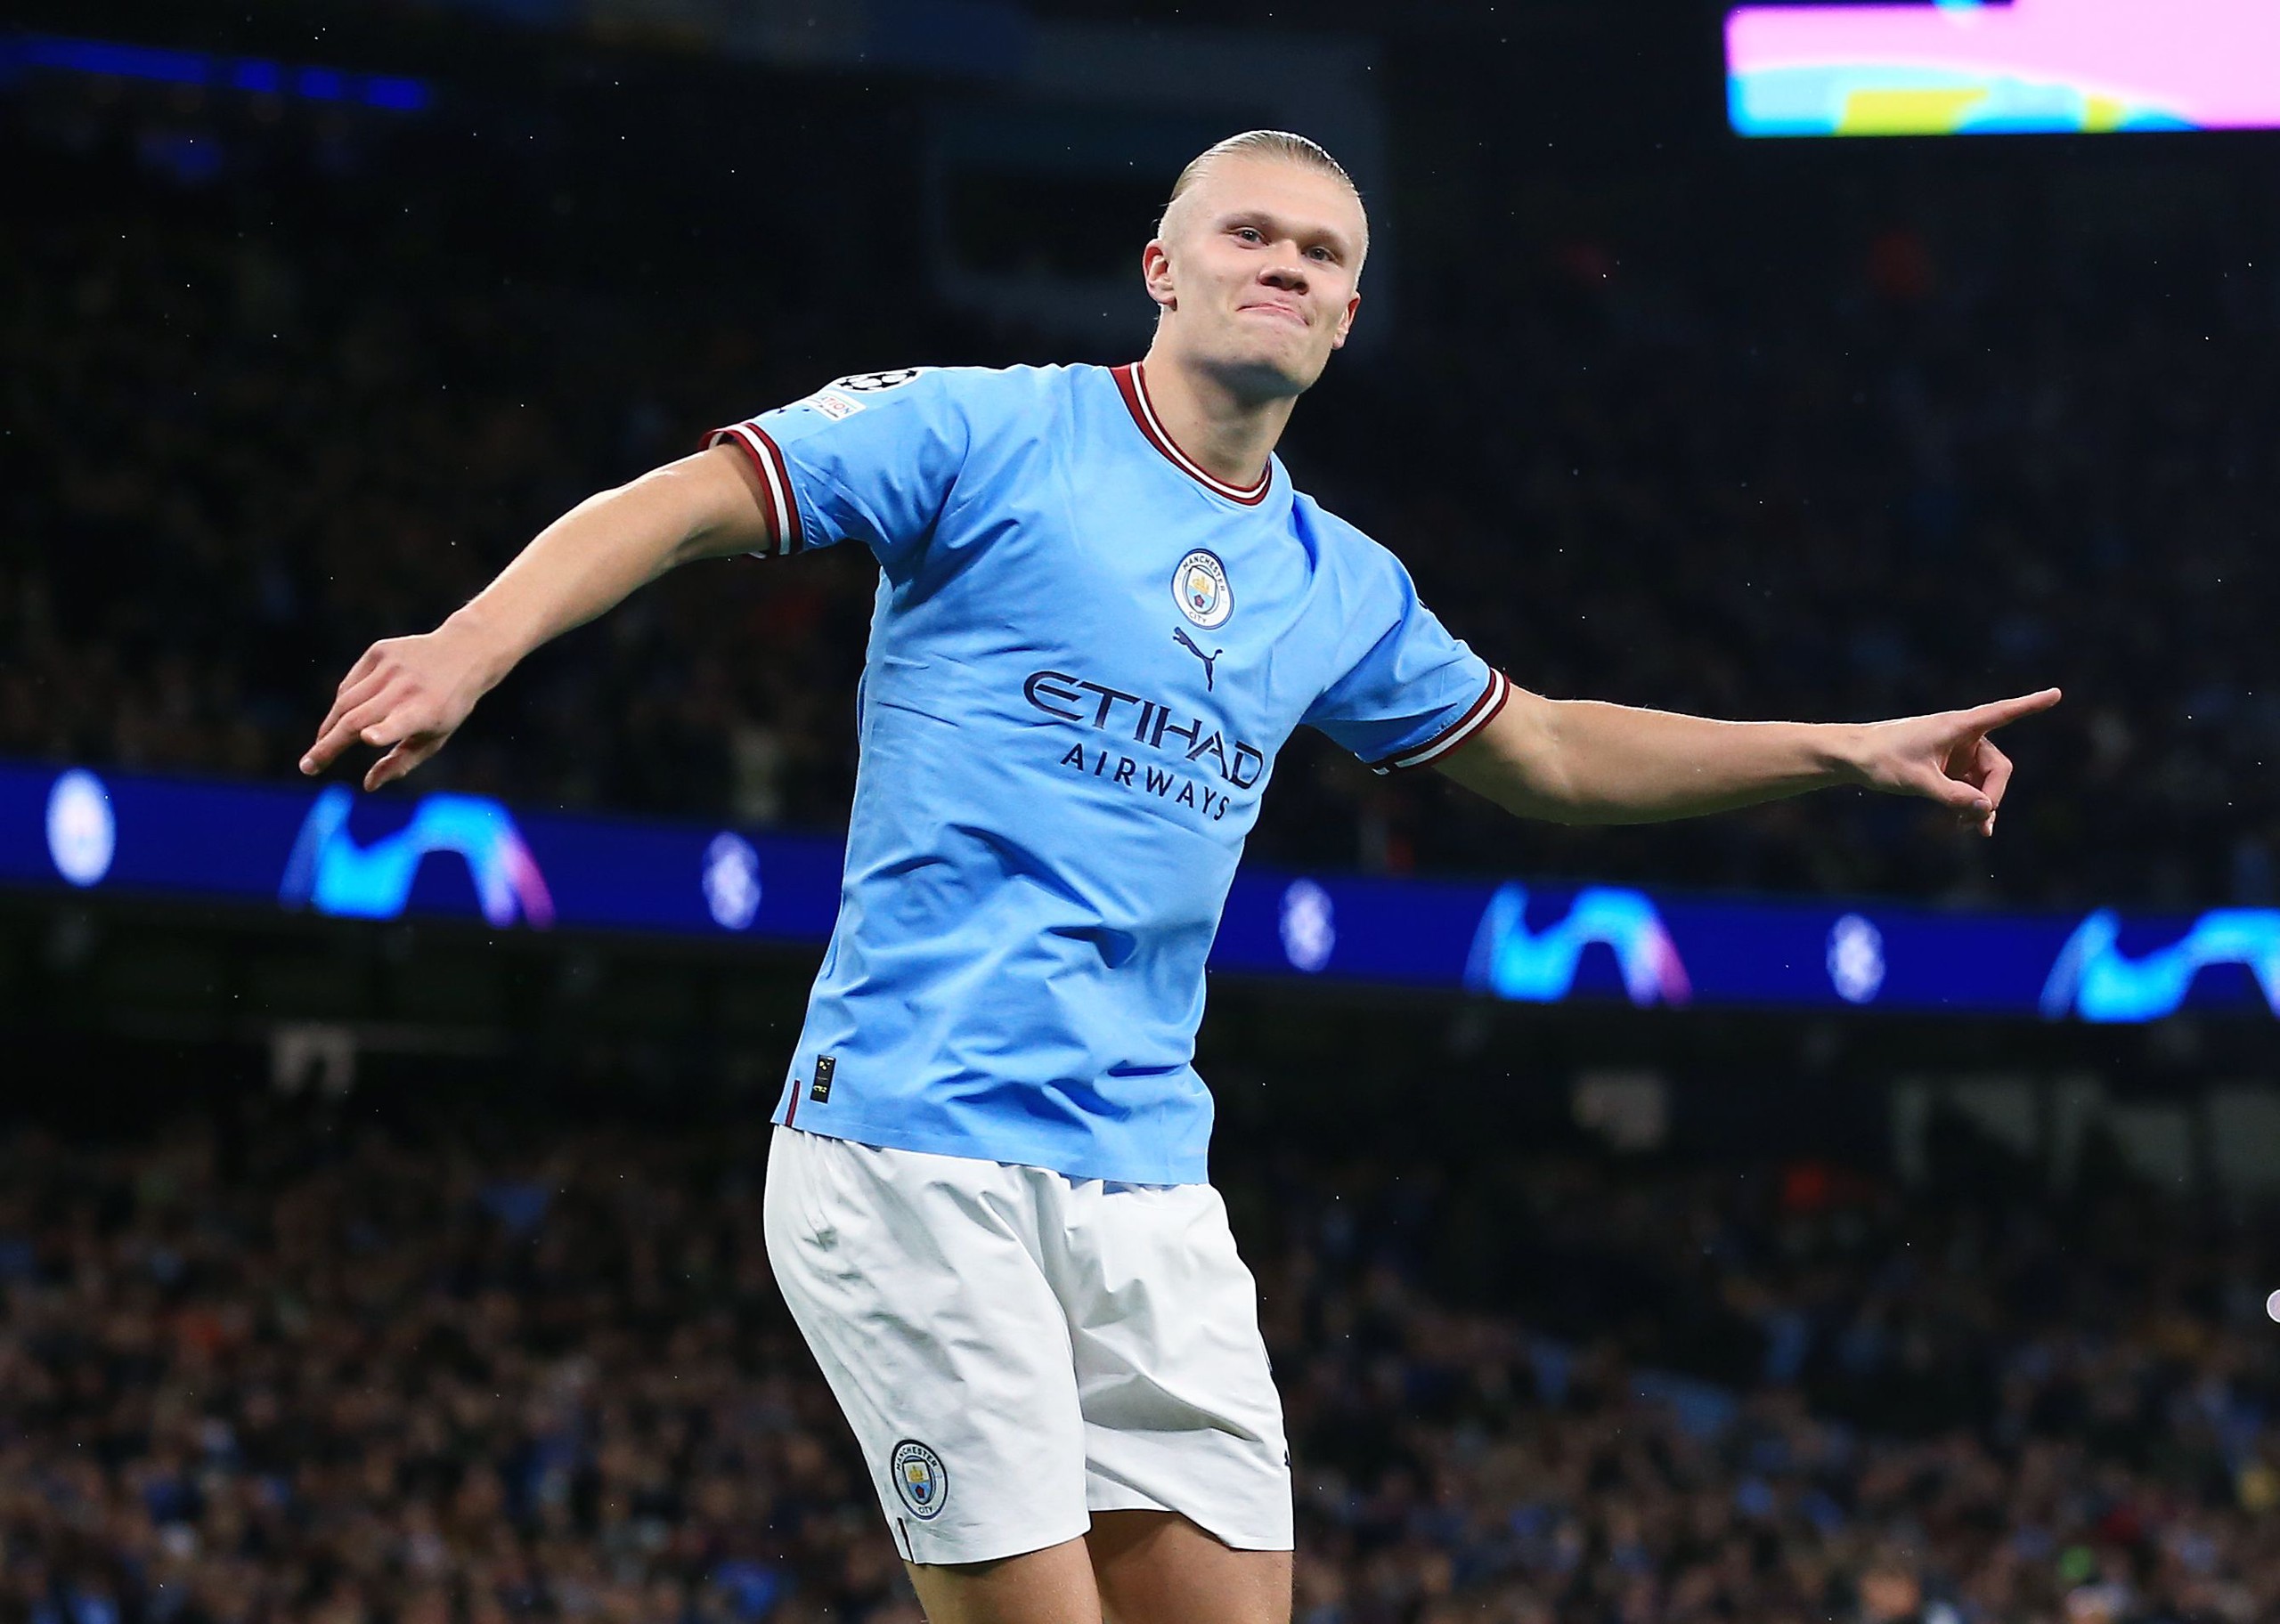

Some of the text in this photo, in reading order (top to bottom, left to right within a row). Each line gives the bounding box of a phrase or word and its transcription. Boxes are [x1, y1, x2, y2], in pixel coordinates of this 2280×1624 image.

[1182, 556, 1226, 592] MANCHESTER
[1189, 611, 1207, 623] CITY
[1023, 670, 1264, 790] ETIHAD
[1060, 743, 1230, 821] AIRWAYS
[896, 1447, 937, 1470] MANCHESTER
